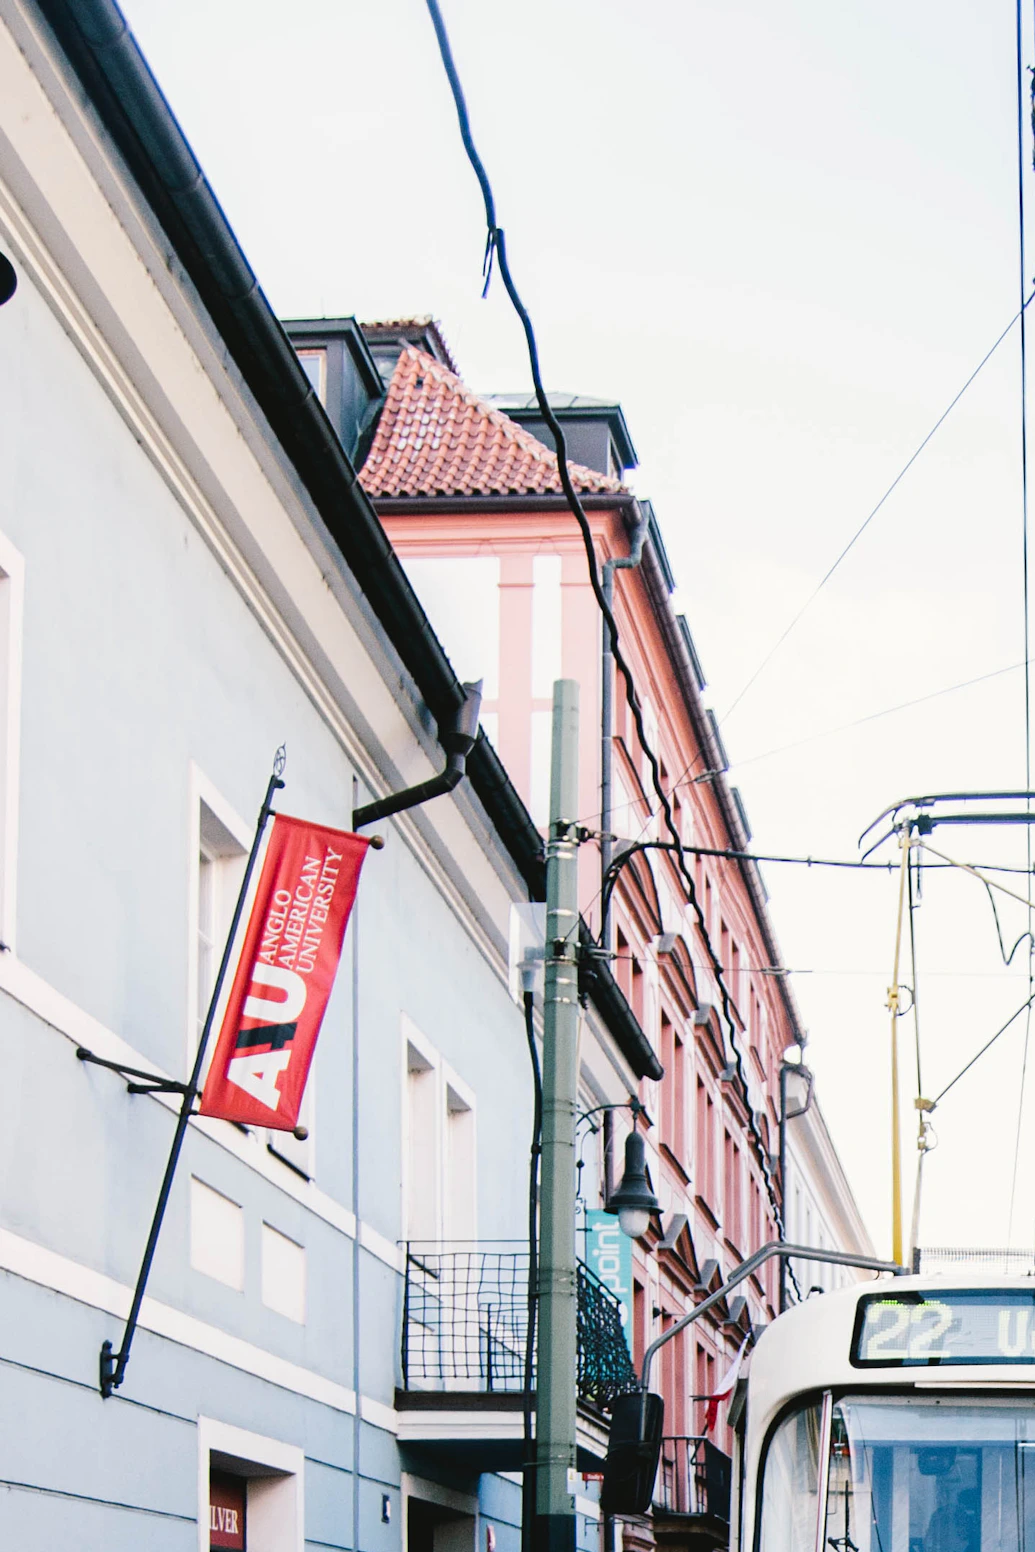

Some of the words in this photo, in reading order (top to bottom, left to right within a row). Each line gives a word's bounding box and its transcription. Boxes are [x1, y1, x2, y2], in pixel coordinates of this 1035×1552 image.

[259, 889, 291, 965] ANGLO
[278, 856, 321, 970] AMERICAN
[296, 846, 343, 973] UNIVERSITY
[865, 1299, 952, 1359] 22
